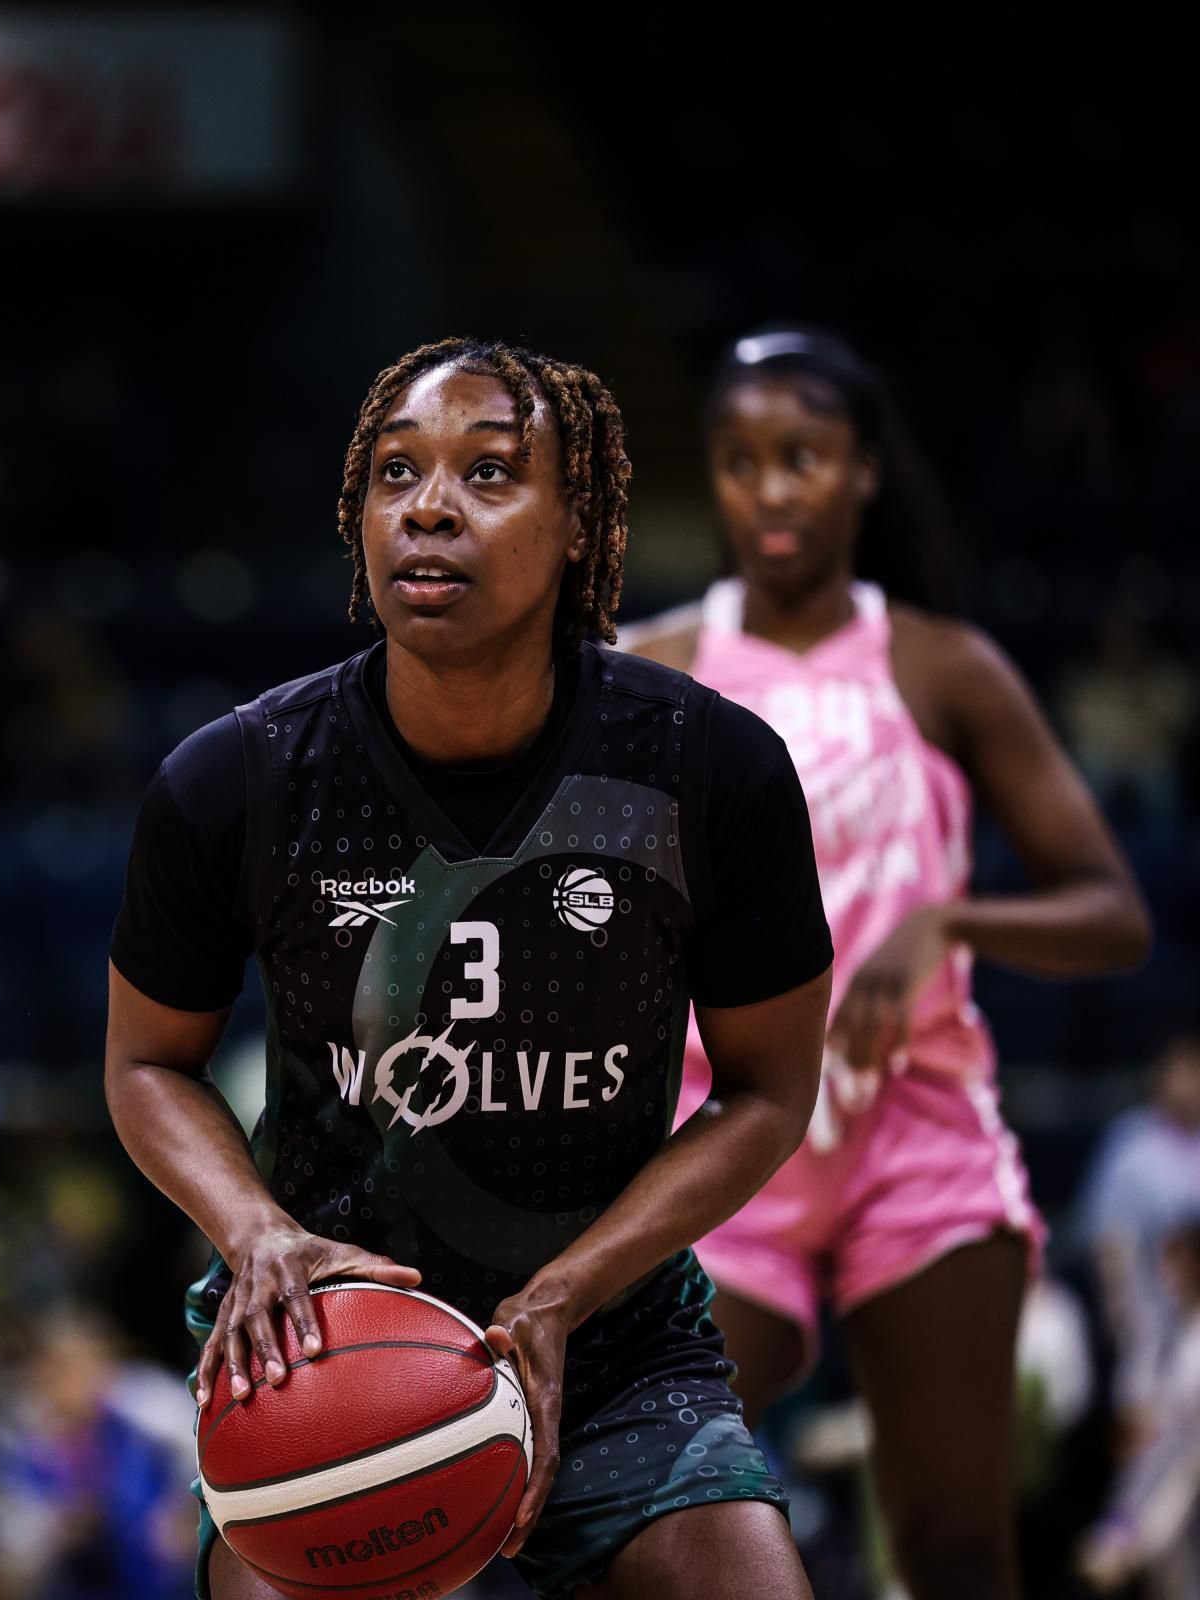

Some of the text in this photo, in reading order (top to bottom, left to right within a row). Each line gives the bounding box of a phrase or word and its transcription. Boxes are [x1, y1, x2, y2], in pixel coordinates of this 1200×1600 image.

[320, 876, 416, 898] Reebok
[568, 893, 615, 908] SLB
[450, 920, 500, 1020] 3
[326, 1021, 629, 1138] WOLVES
[305, 1507, 449, 1569] molten
